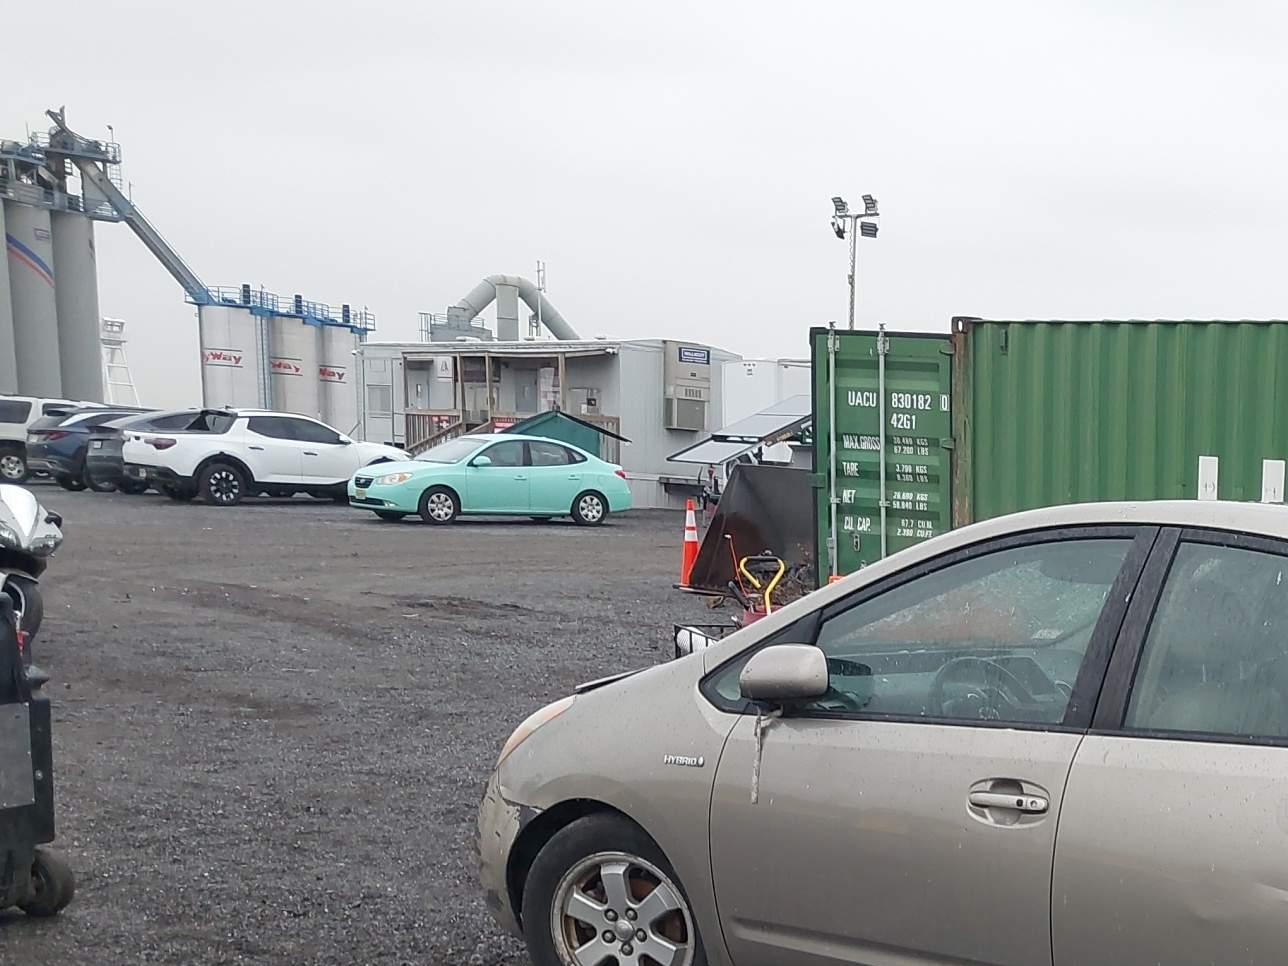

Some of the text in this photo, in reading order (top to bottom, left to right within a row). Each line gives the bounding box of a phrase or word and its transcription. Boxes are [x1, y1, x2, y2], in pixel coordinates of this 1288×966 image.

[848, 391, 876, 407] UACU
[891, 393, 932, 409] 830182
[890, 413, 916, 429] 42G1
[842, 462, 859, 477] TARE
[842, 489, 856, 504] NET
[663, 754, 698, 766] HYBRID
